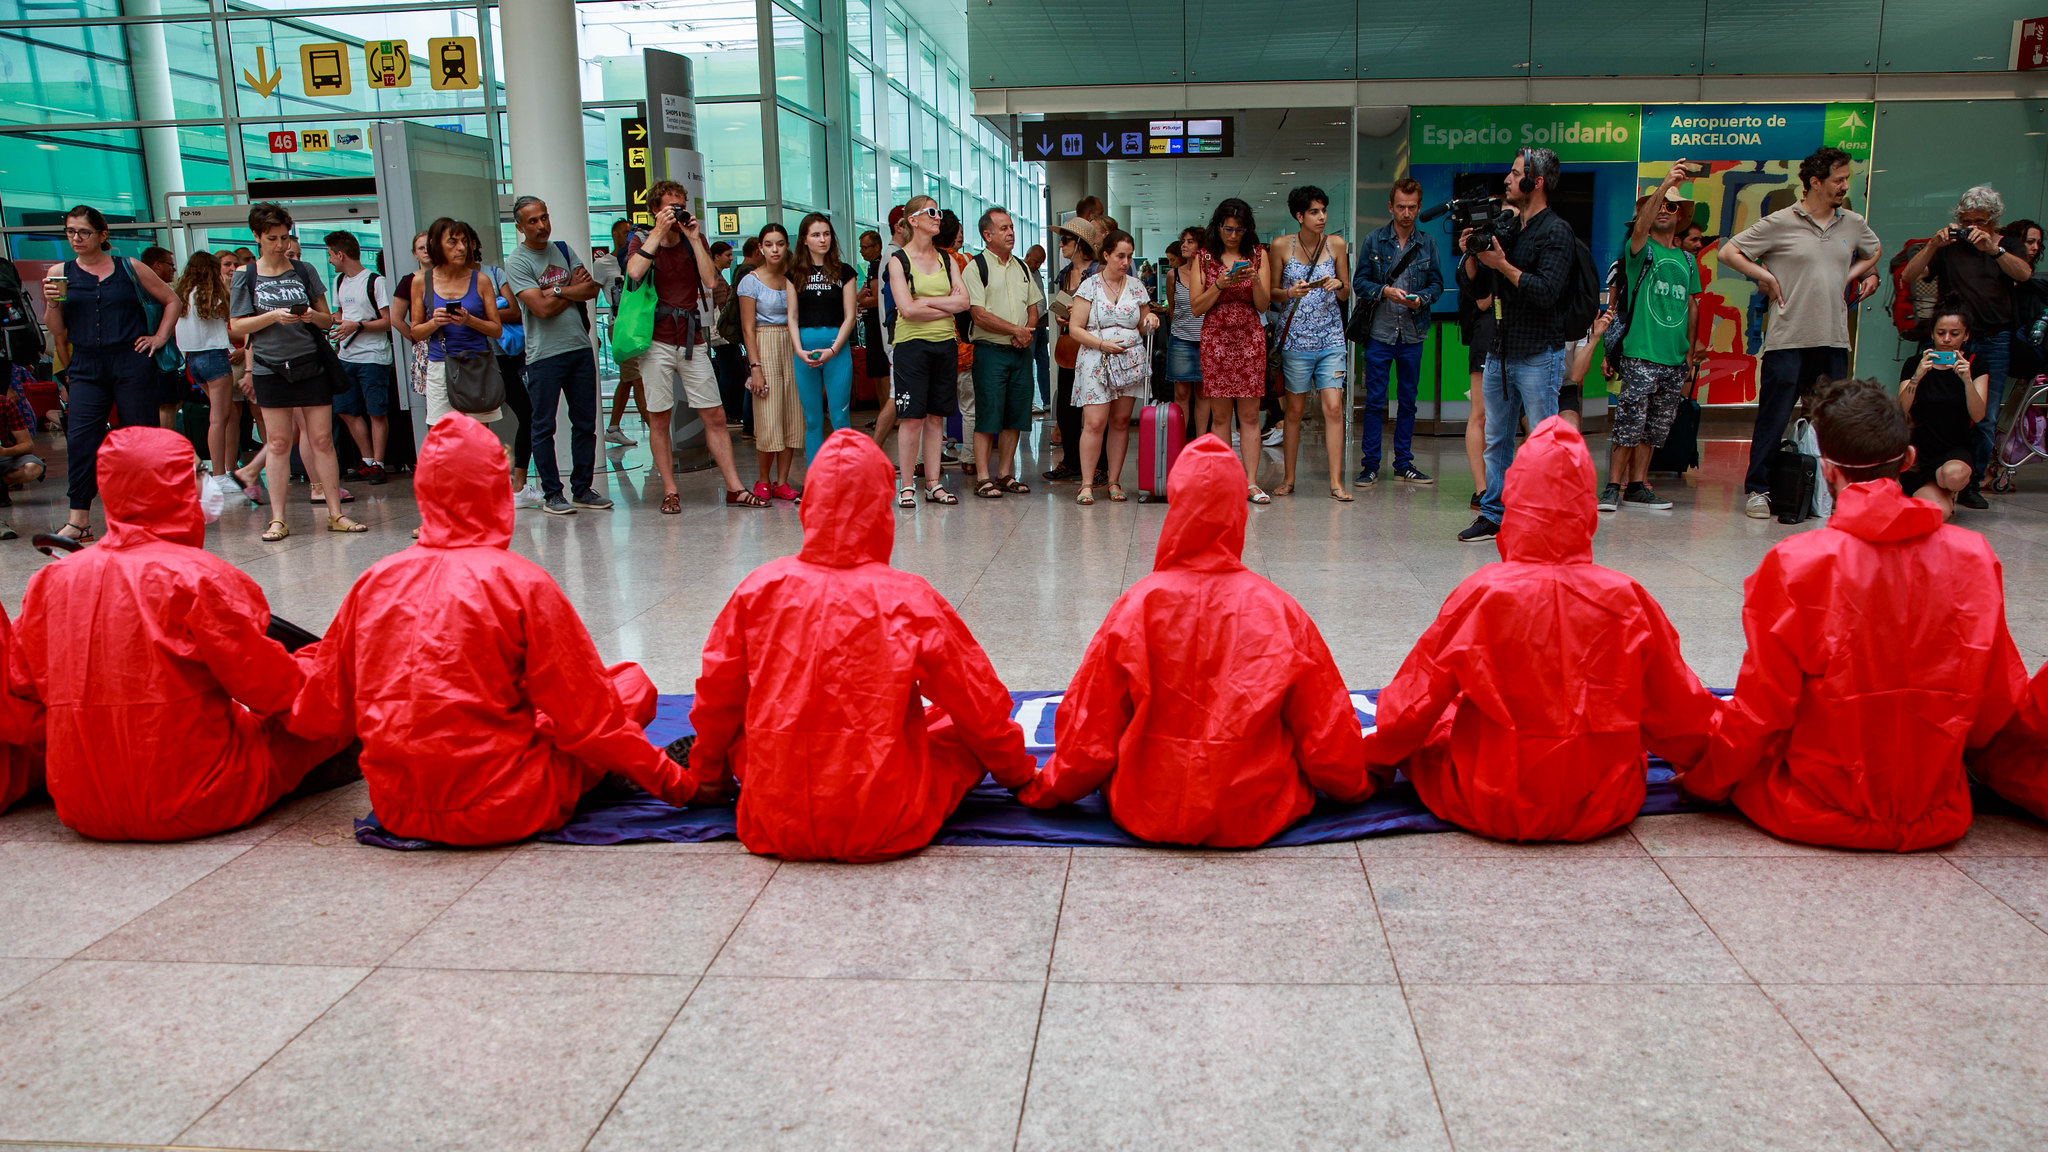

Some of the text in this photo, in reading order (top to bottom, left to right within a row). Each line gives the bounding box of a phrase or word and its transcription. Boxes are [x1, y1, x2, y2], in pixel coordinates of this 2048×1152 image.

[382, 44, 391, 52] T1
[385, 76, 395, 84] T2
[1671, 114, 1787, 130] Aeropuerto de
[303, 133, 328, 148] PR1
[1423, 121, 1629, 149] Espacio Solidario
[1671, 133, 1762, 145] BARCELONA
[274, 135, 292, 149] 46
[1837, 140, 1867, 149] Aena
